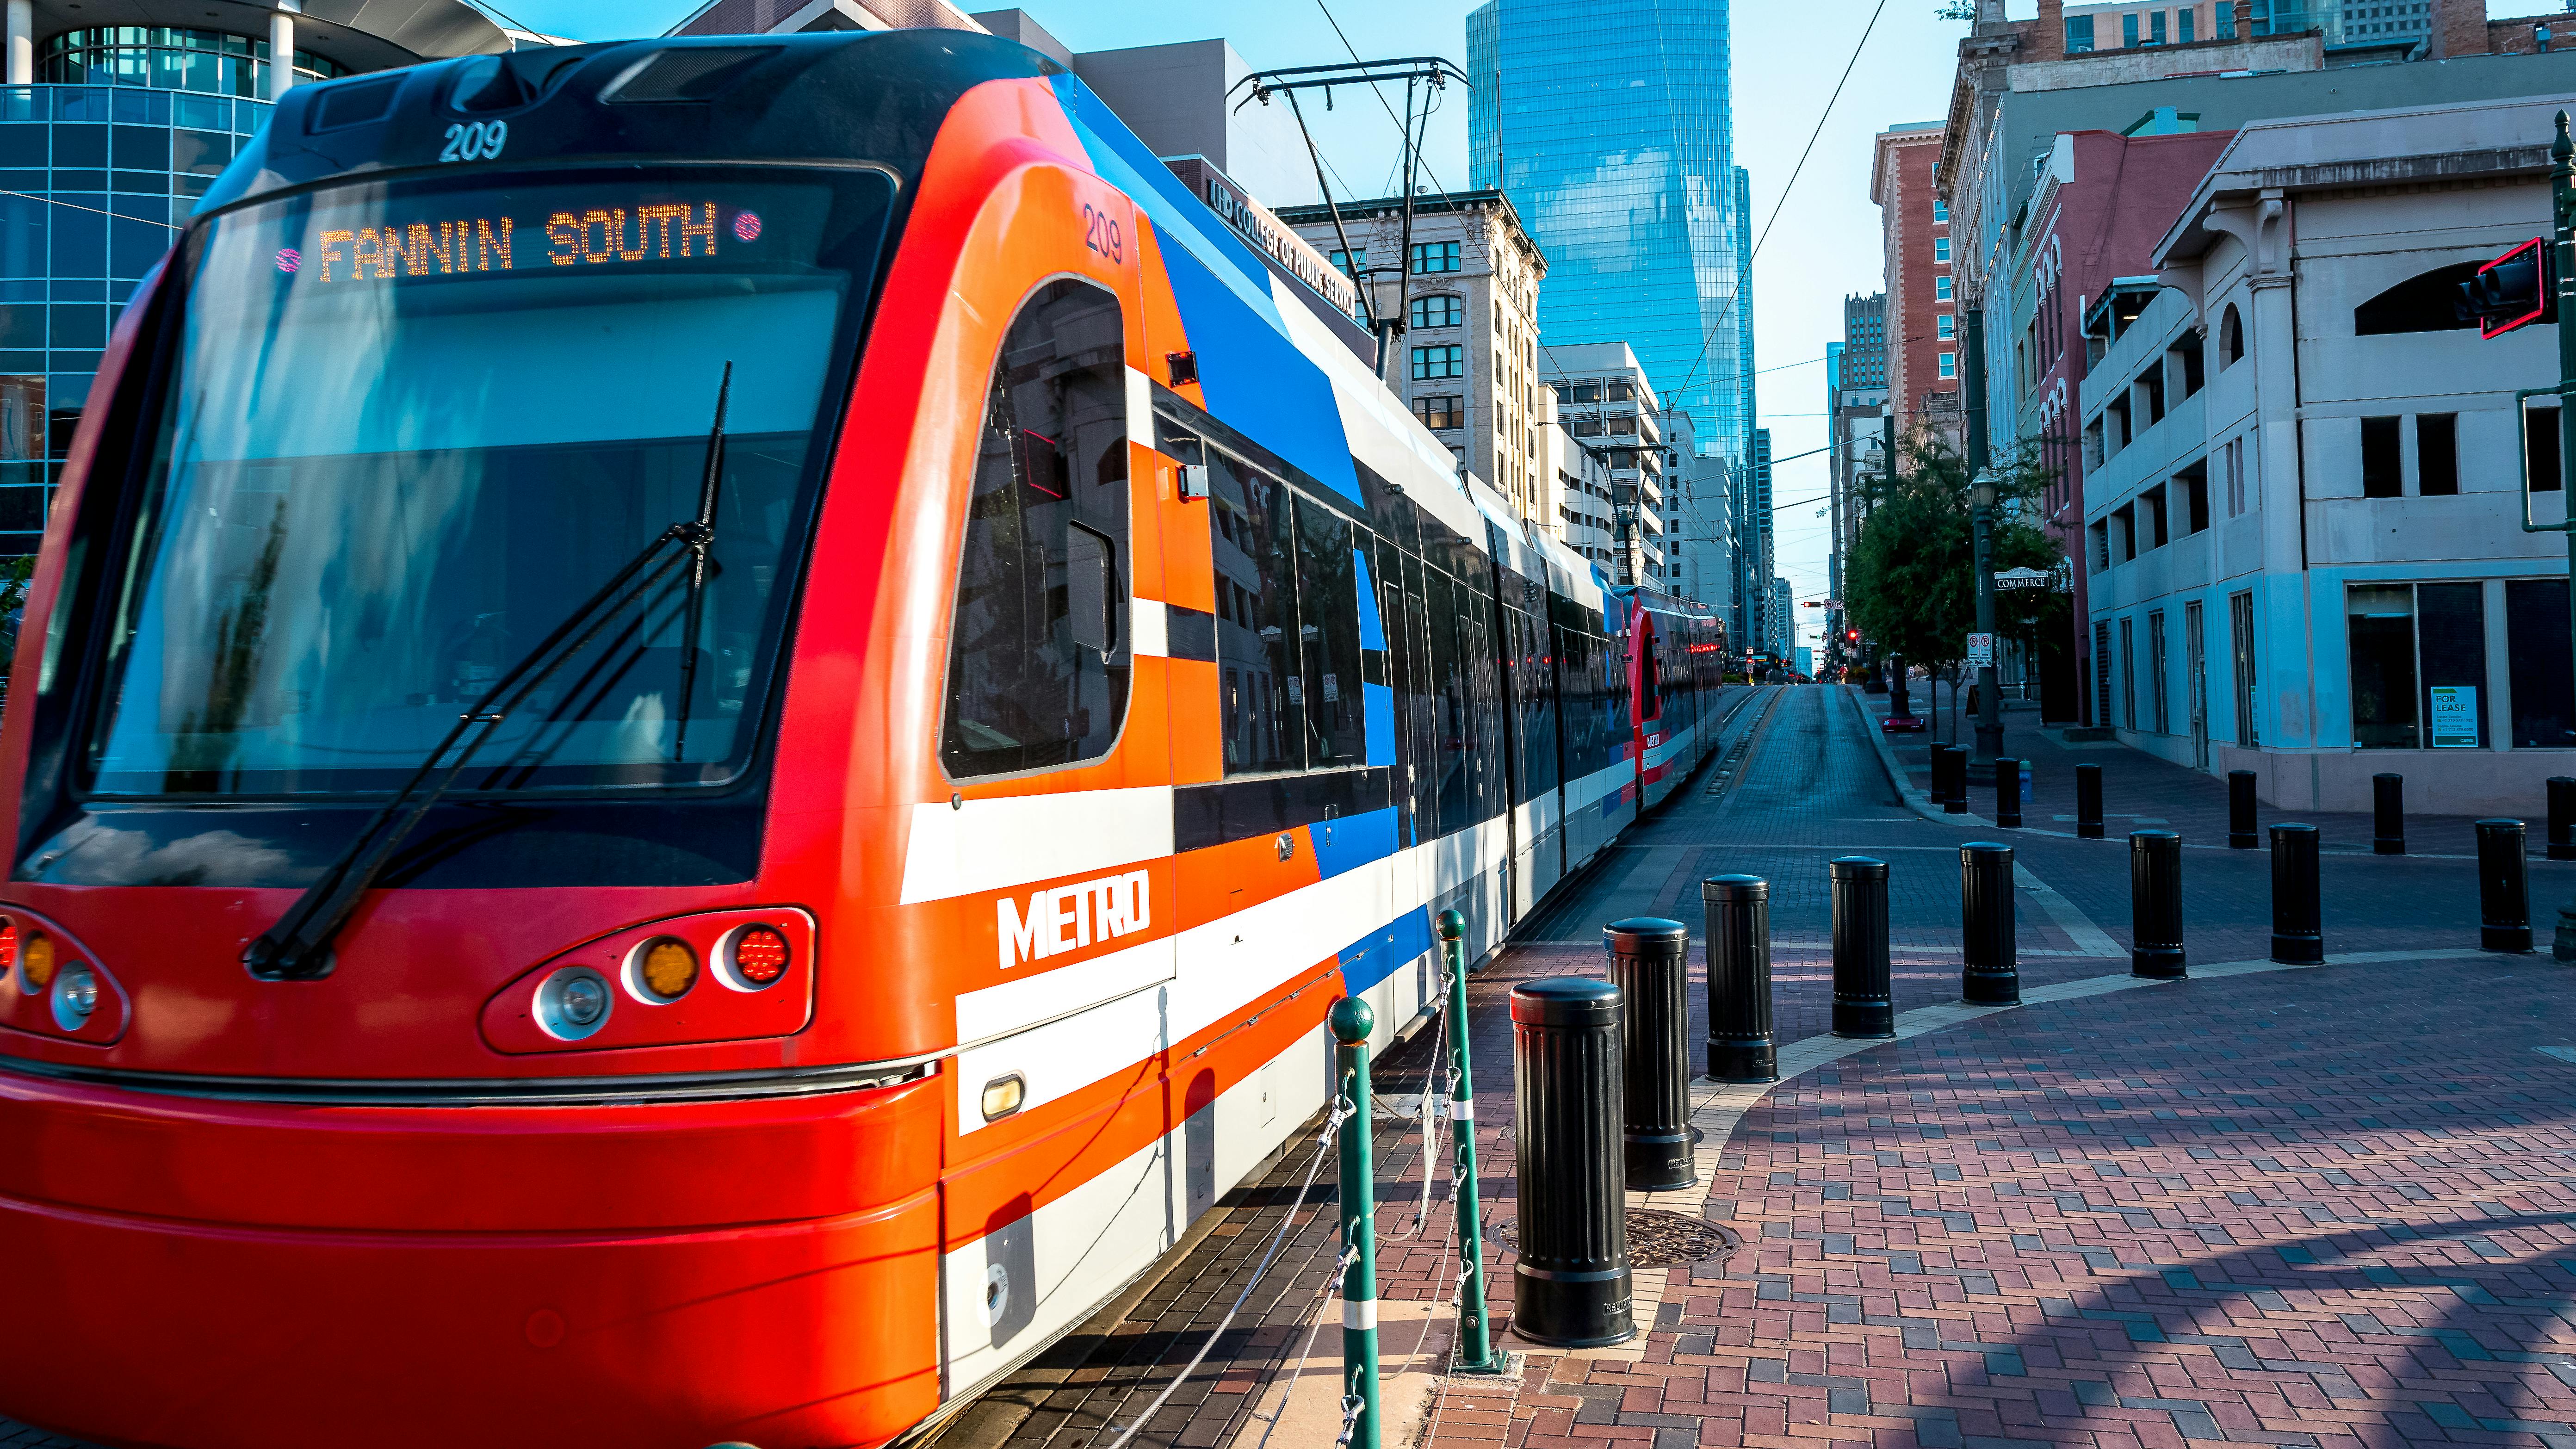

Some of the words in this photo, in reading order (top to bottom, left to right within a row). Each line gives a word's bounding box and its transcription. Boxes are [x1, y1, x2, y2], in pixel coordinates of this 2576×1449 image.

[439, 119, 508, 162] 209
[319, 217, 512, 282] FANNIN
[546, 202, 716, 265] SOUTH
[1084, 203, 1122, 264] 209
[1209, 178, 1232, 219] UHD
[1235, 201, 1279, 259] COLLEGE
[1281, 237, 1294, 270] OF
[1295, 248, 1324, 292] PUBLIC
[1997, 578, 2045, 588] COMMERCE
[997, 869, 1150, 970] METRO
